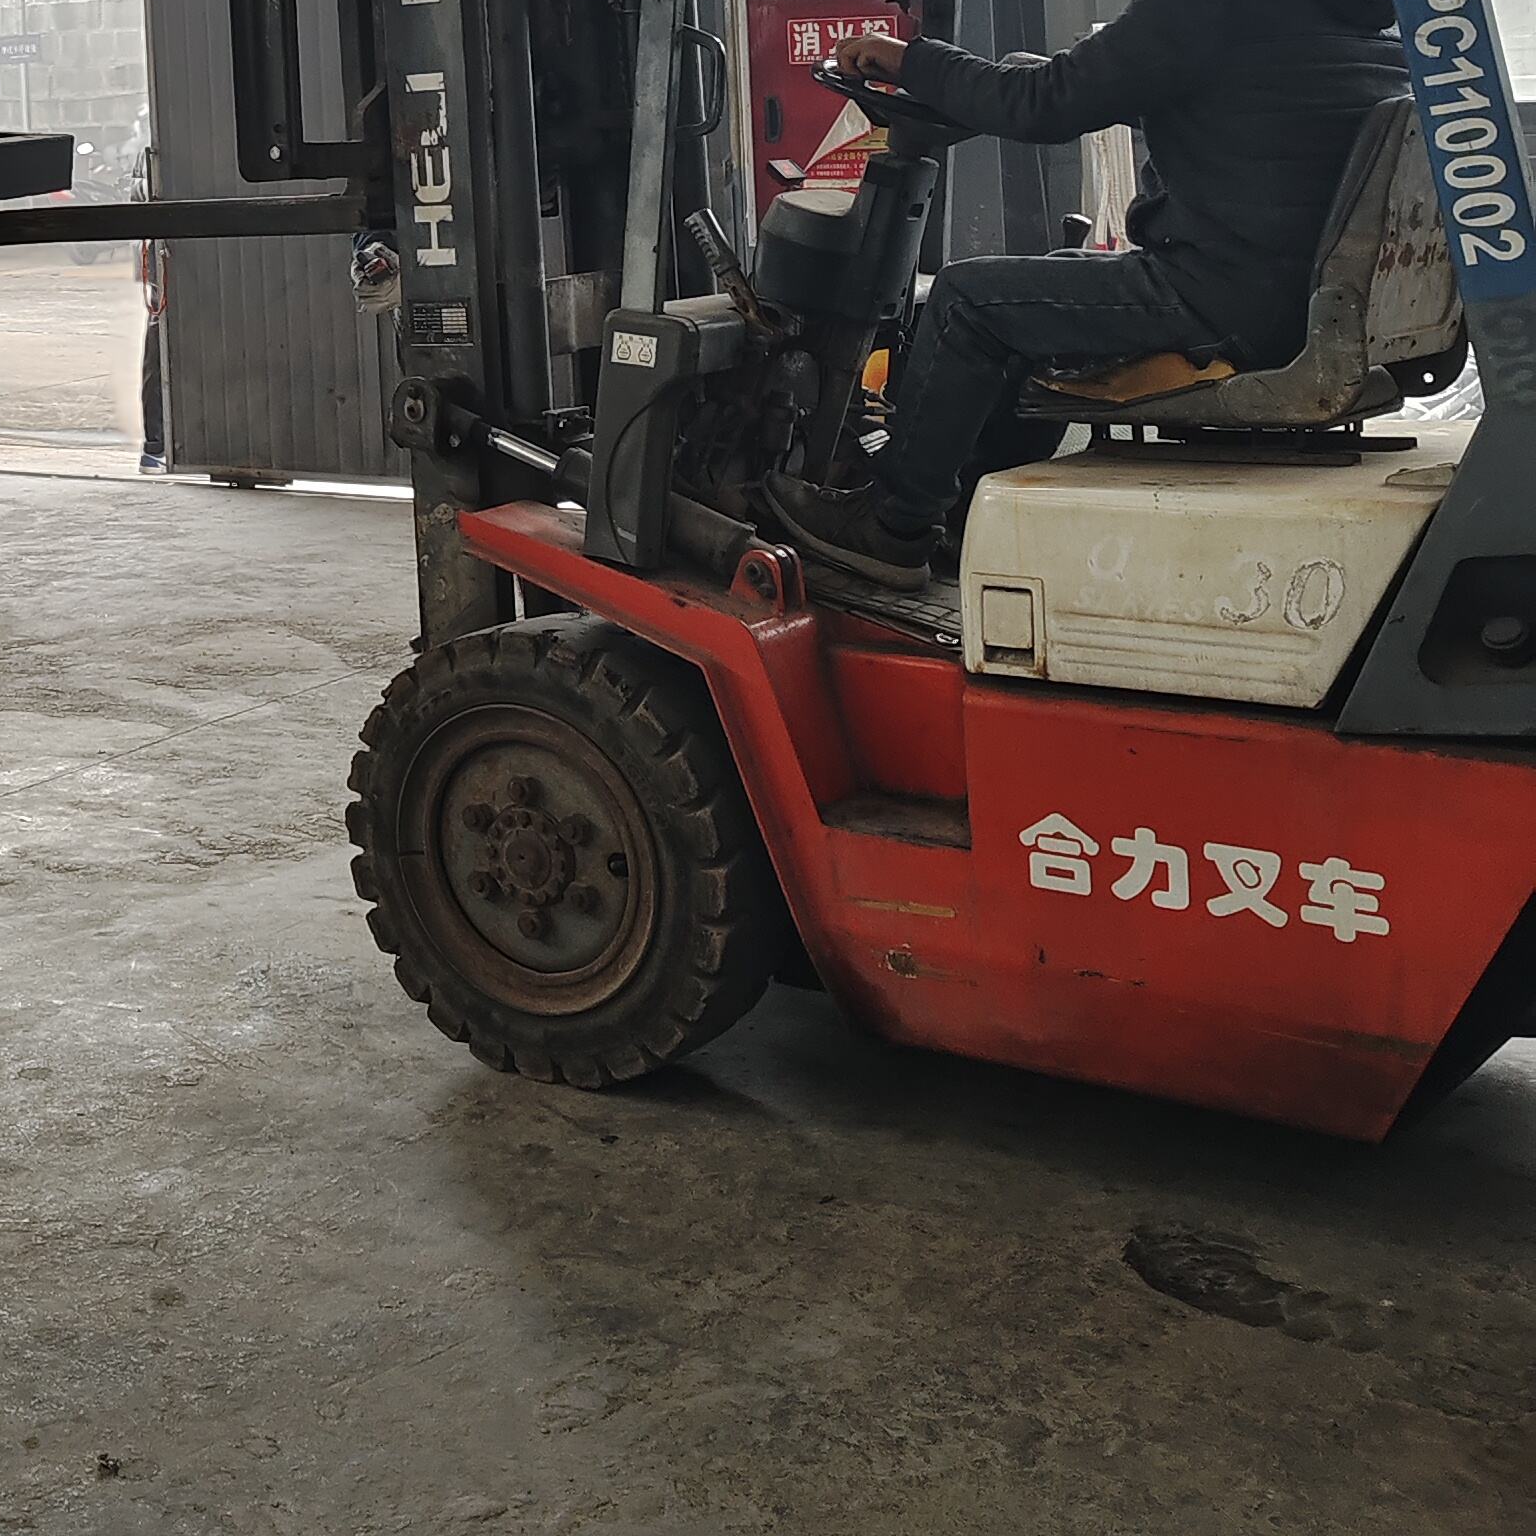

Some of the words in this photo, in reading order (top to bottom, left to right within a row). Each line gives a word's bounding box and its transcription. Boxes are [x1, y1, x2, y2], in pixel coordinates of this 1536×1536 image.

[404, 71, 458, 266] HELI
[1018, 812, 1391, 943] 合力叉车
